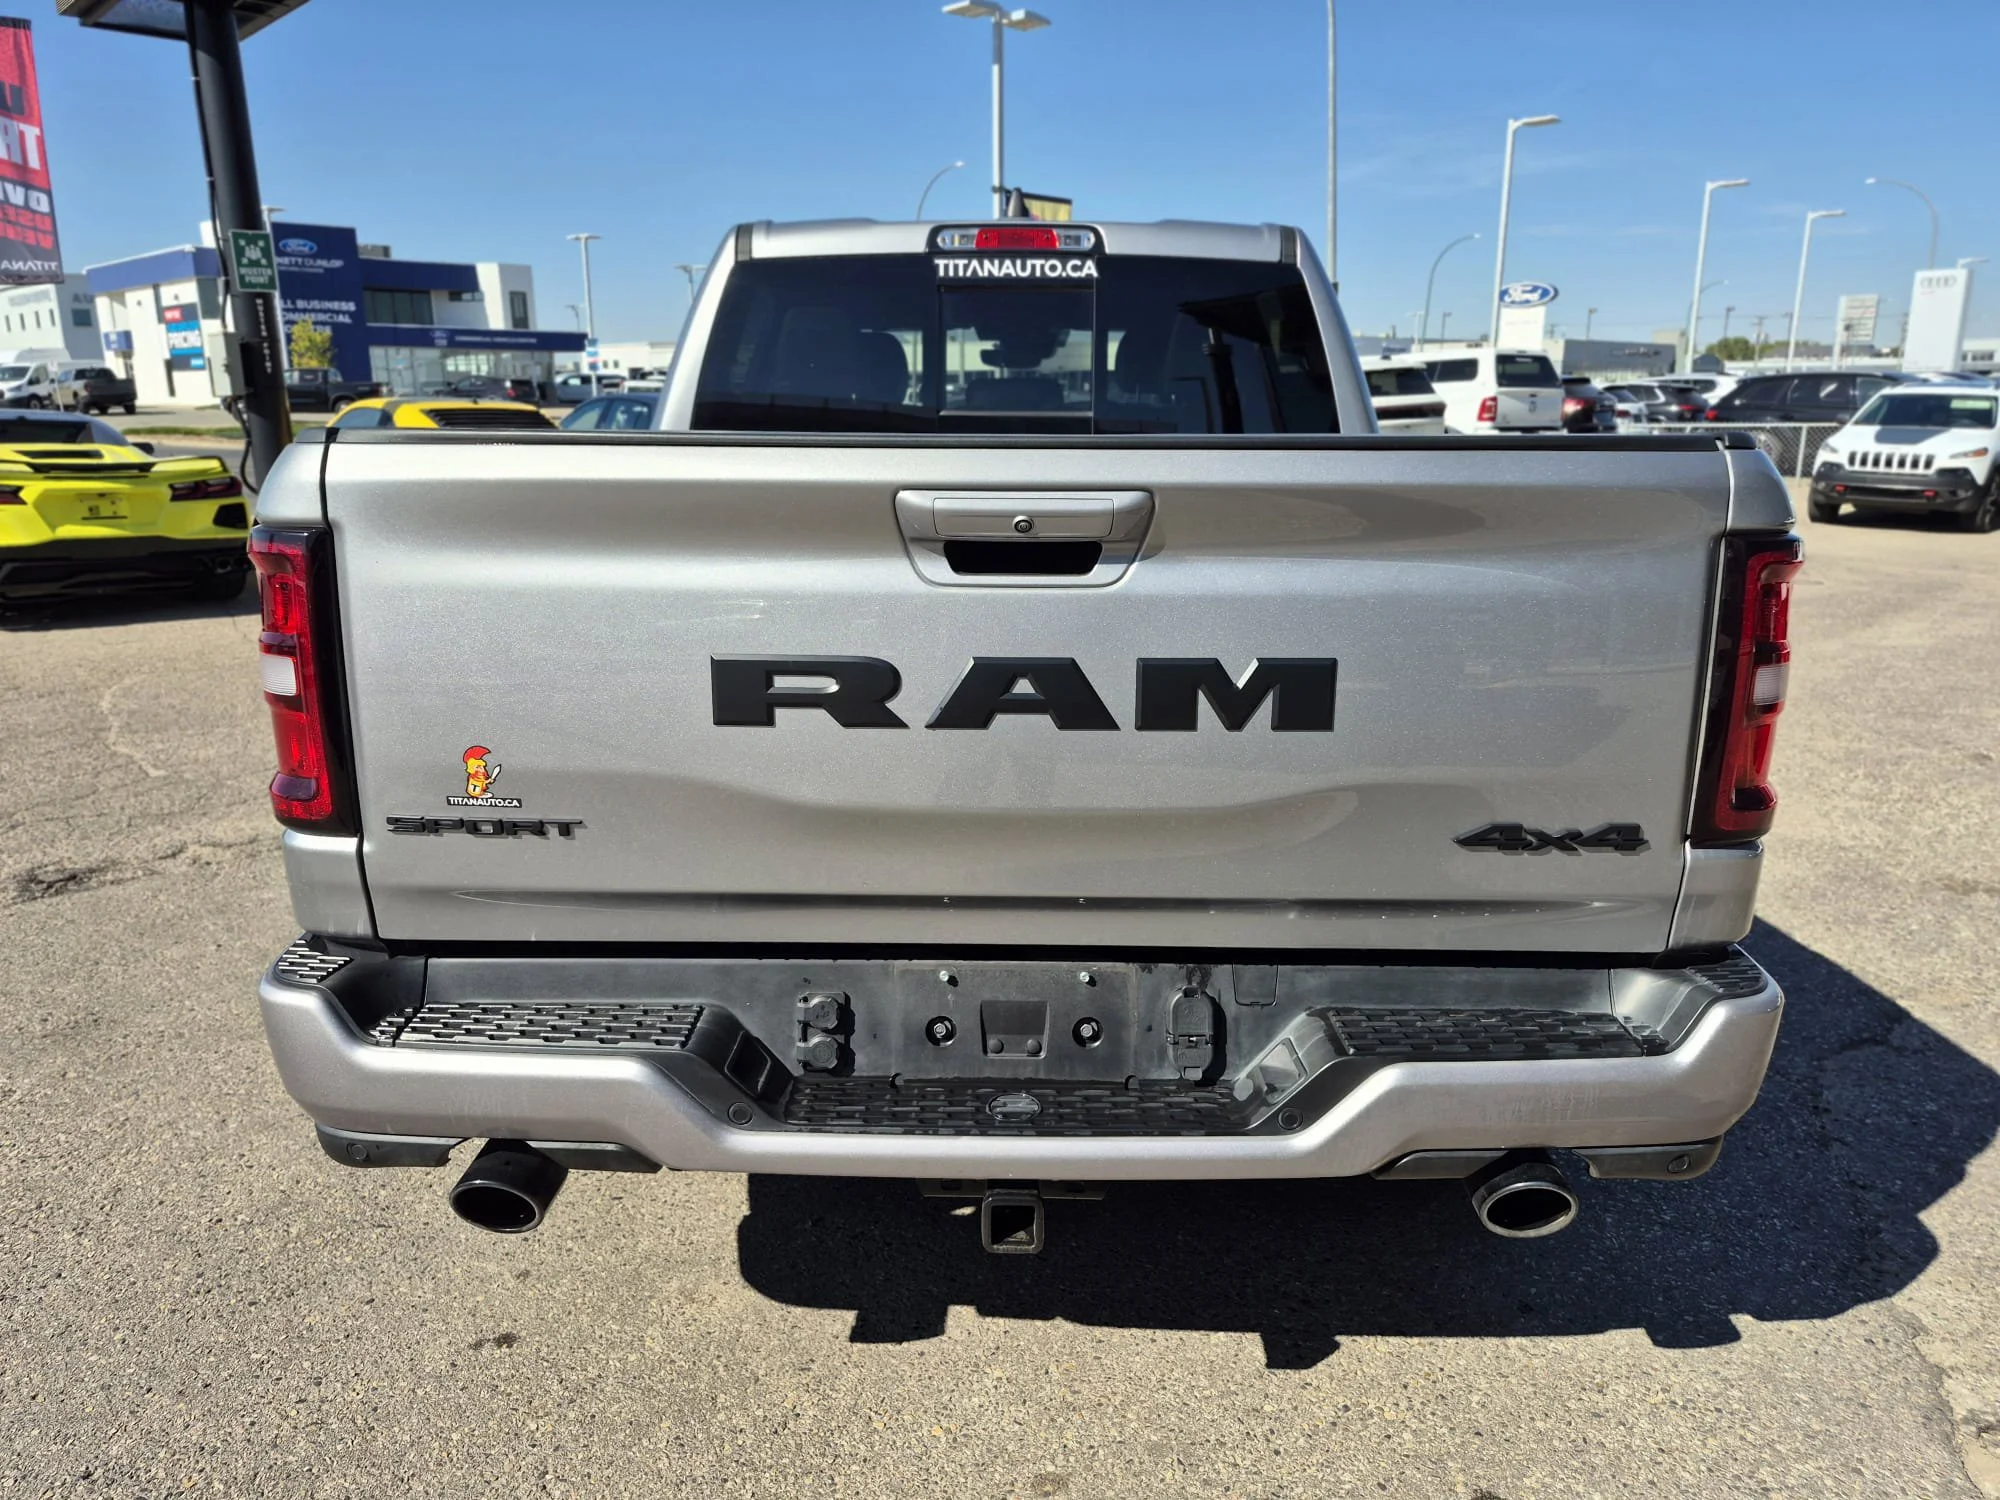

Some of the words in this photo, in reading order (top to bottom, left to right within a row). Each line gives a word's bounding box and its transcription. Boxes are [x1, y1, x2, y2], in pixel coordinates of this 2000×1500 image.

[934, 258, 1099, 278] TITANAUTO.CA
[244, 276, 270, 284] POINT
[296, 299, 357, 311] BUSINESS
[710, 653, 1338, 731] RAM
[448, 797, 520, 807] TITANAUTO.CA
[386, 814, 583, 837] SPORT
